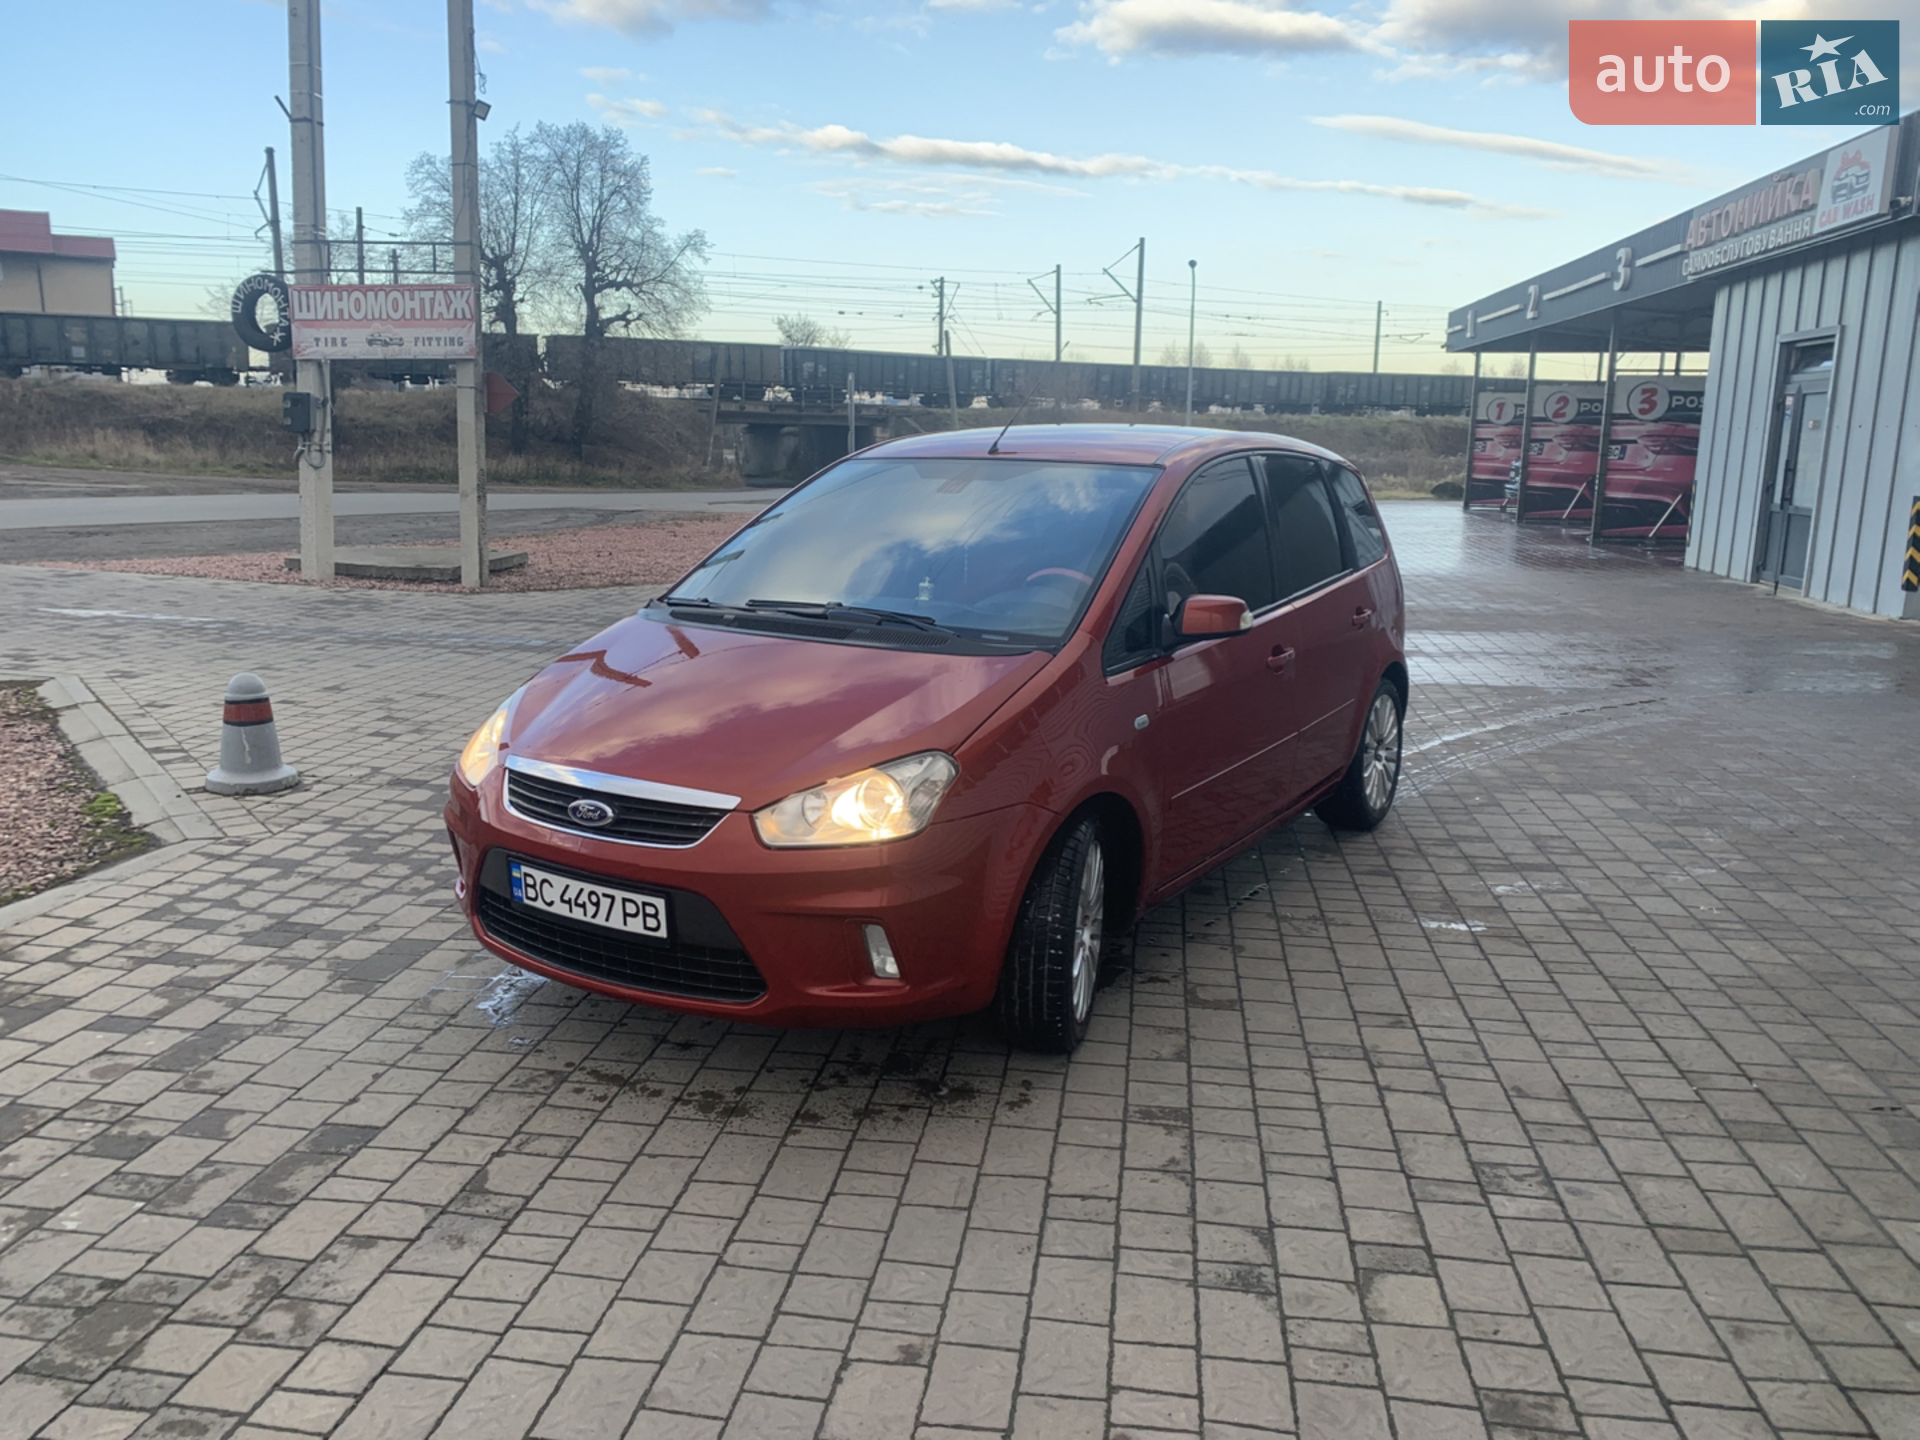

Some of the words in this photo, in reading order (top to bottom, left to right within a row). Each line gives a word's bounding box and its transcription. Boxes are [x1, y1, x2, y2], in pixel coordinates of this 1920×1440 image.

[1685, 172, 1818, 251] АВТОМИЙКА
[1843, 193, 1875, 220] WASH
[1682, 216, 1813, 276] САМООБСЛУГОВУВАННЯ
[1612, 247, 1632, 291] 3
[232, 276, 290, 346] ШИНОМОНТАЖ
[292, 288, 474, 321] ШИНОМОНТАЖ
[1525, 284, 1540, 320] 2
[1465, 310, 1476, 338] 1
[313, 337, 348, 348] TIRE
[414, 336, 464, 348] FITTING
[1496, 402, 1507, 421] 1
[1551, 395, 1570, 419] 2
[1638, 387, 1659, 416] 3
[575, 803, 601, 820] Ford
[523, 872, 555, 907] BC
[559, 884, 616, 923] 4497
[621, 897, 662, 933] PB
